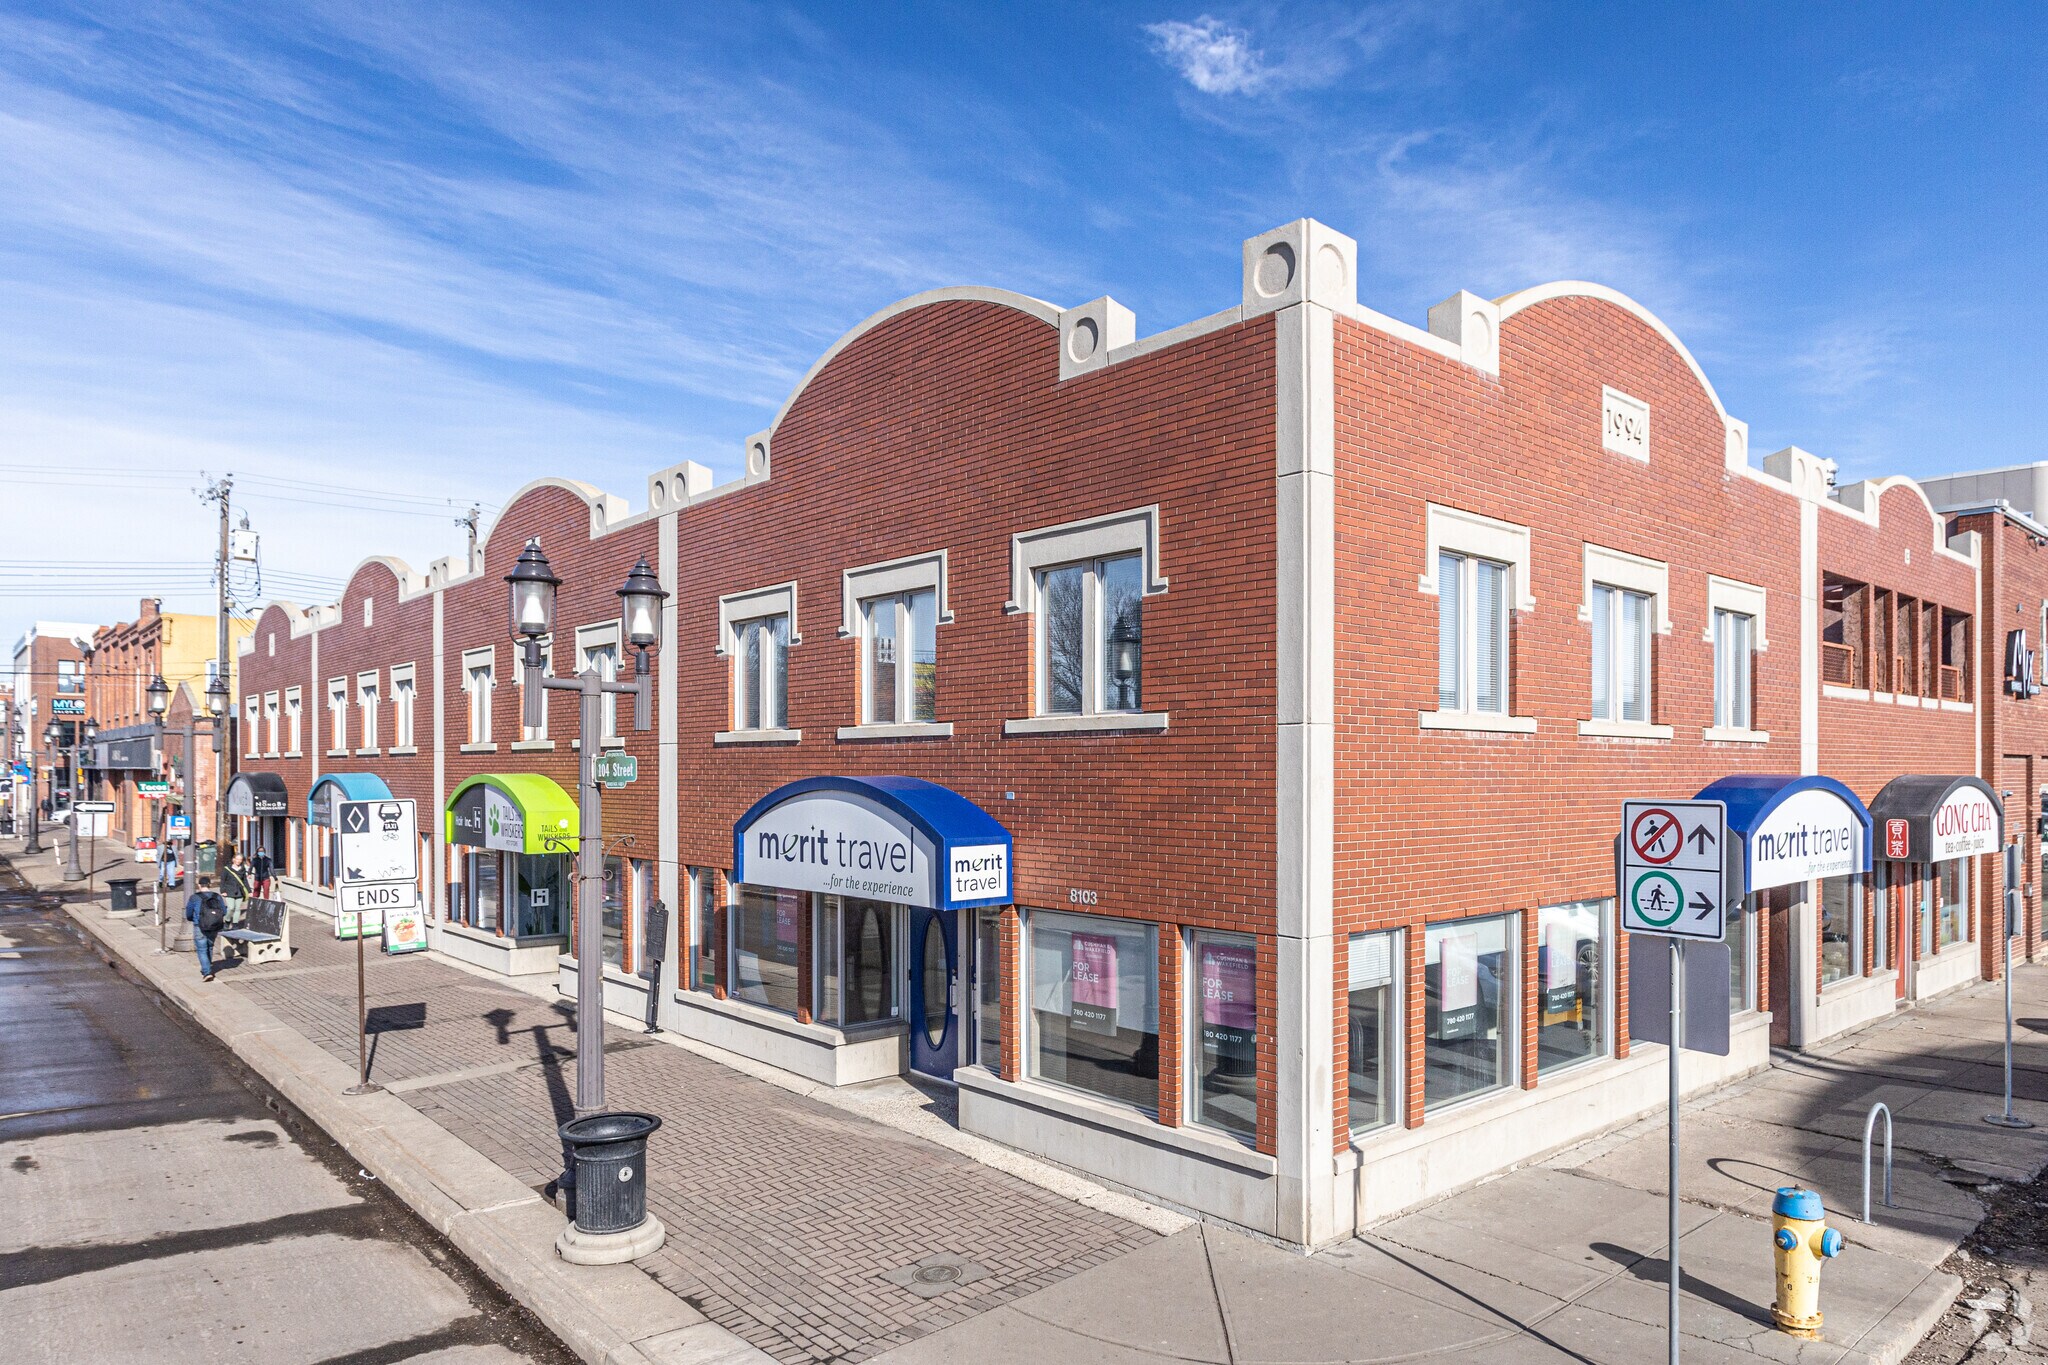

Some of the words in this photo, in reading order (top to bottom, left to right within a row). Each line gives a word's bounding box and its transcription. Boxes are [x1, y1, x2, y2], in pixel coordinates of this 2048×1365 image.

[1606, 406, 1642, 445] 1994
[598, 763, 610, 777] 104
[612, 762, 634, 777] Street
[140, 783, 167, 791] Tacos
[384, 823, 398, 831] TAXI
[1936, 804, 1969, 836] GONG
[1971, 803, 1991, 832] CHA
[1758, 822, 1808, 862] merit
[1812, 813, 1853, 856] travel
[759, 825, 828, 865] merit
[836, 827, 914, 874] travel
[955, 853, 1003, 873] merit
[845, 876, 860, 890] the
[862, 880, 914, 897] experience
[956, 870, 1001, 893] travel
[357, 888, 400, 906] ENDS
[1070, 889, 1098, 905] 8103
[1072, 961, 1090, 973] FOR
[1072, 970, 1099, 984] LEASE
[1202, 977, 1223, 990] FOR
[1202, 987, 1234, 1002] LEASE
[1073, 1008, 1084, 1017] 780
[1084, 1010, 1095, 1019] 420
[1214, 1032, 1228, 1041] 420
[1229, 1034, 1243, 1044] 1177
